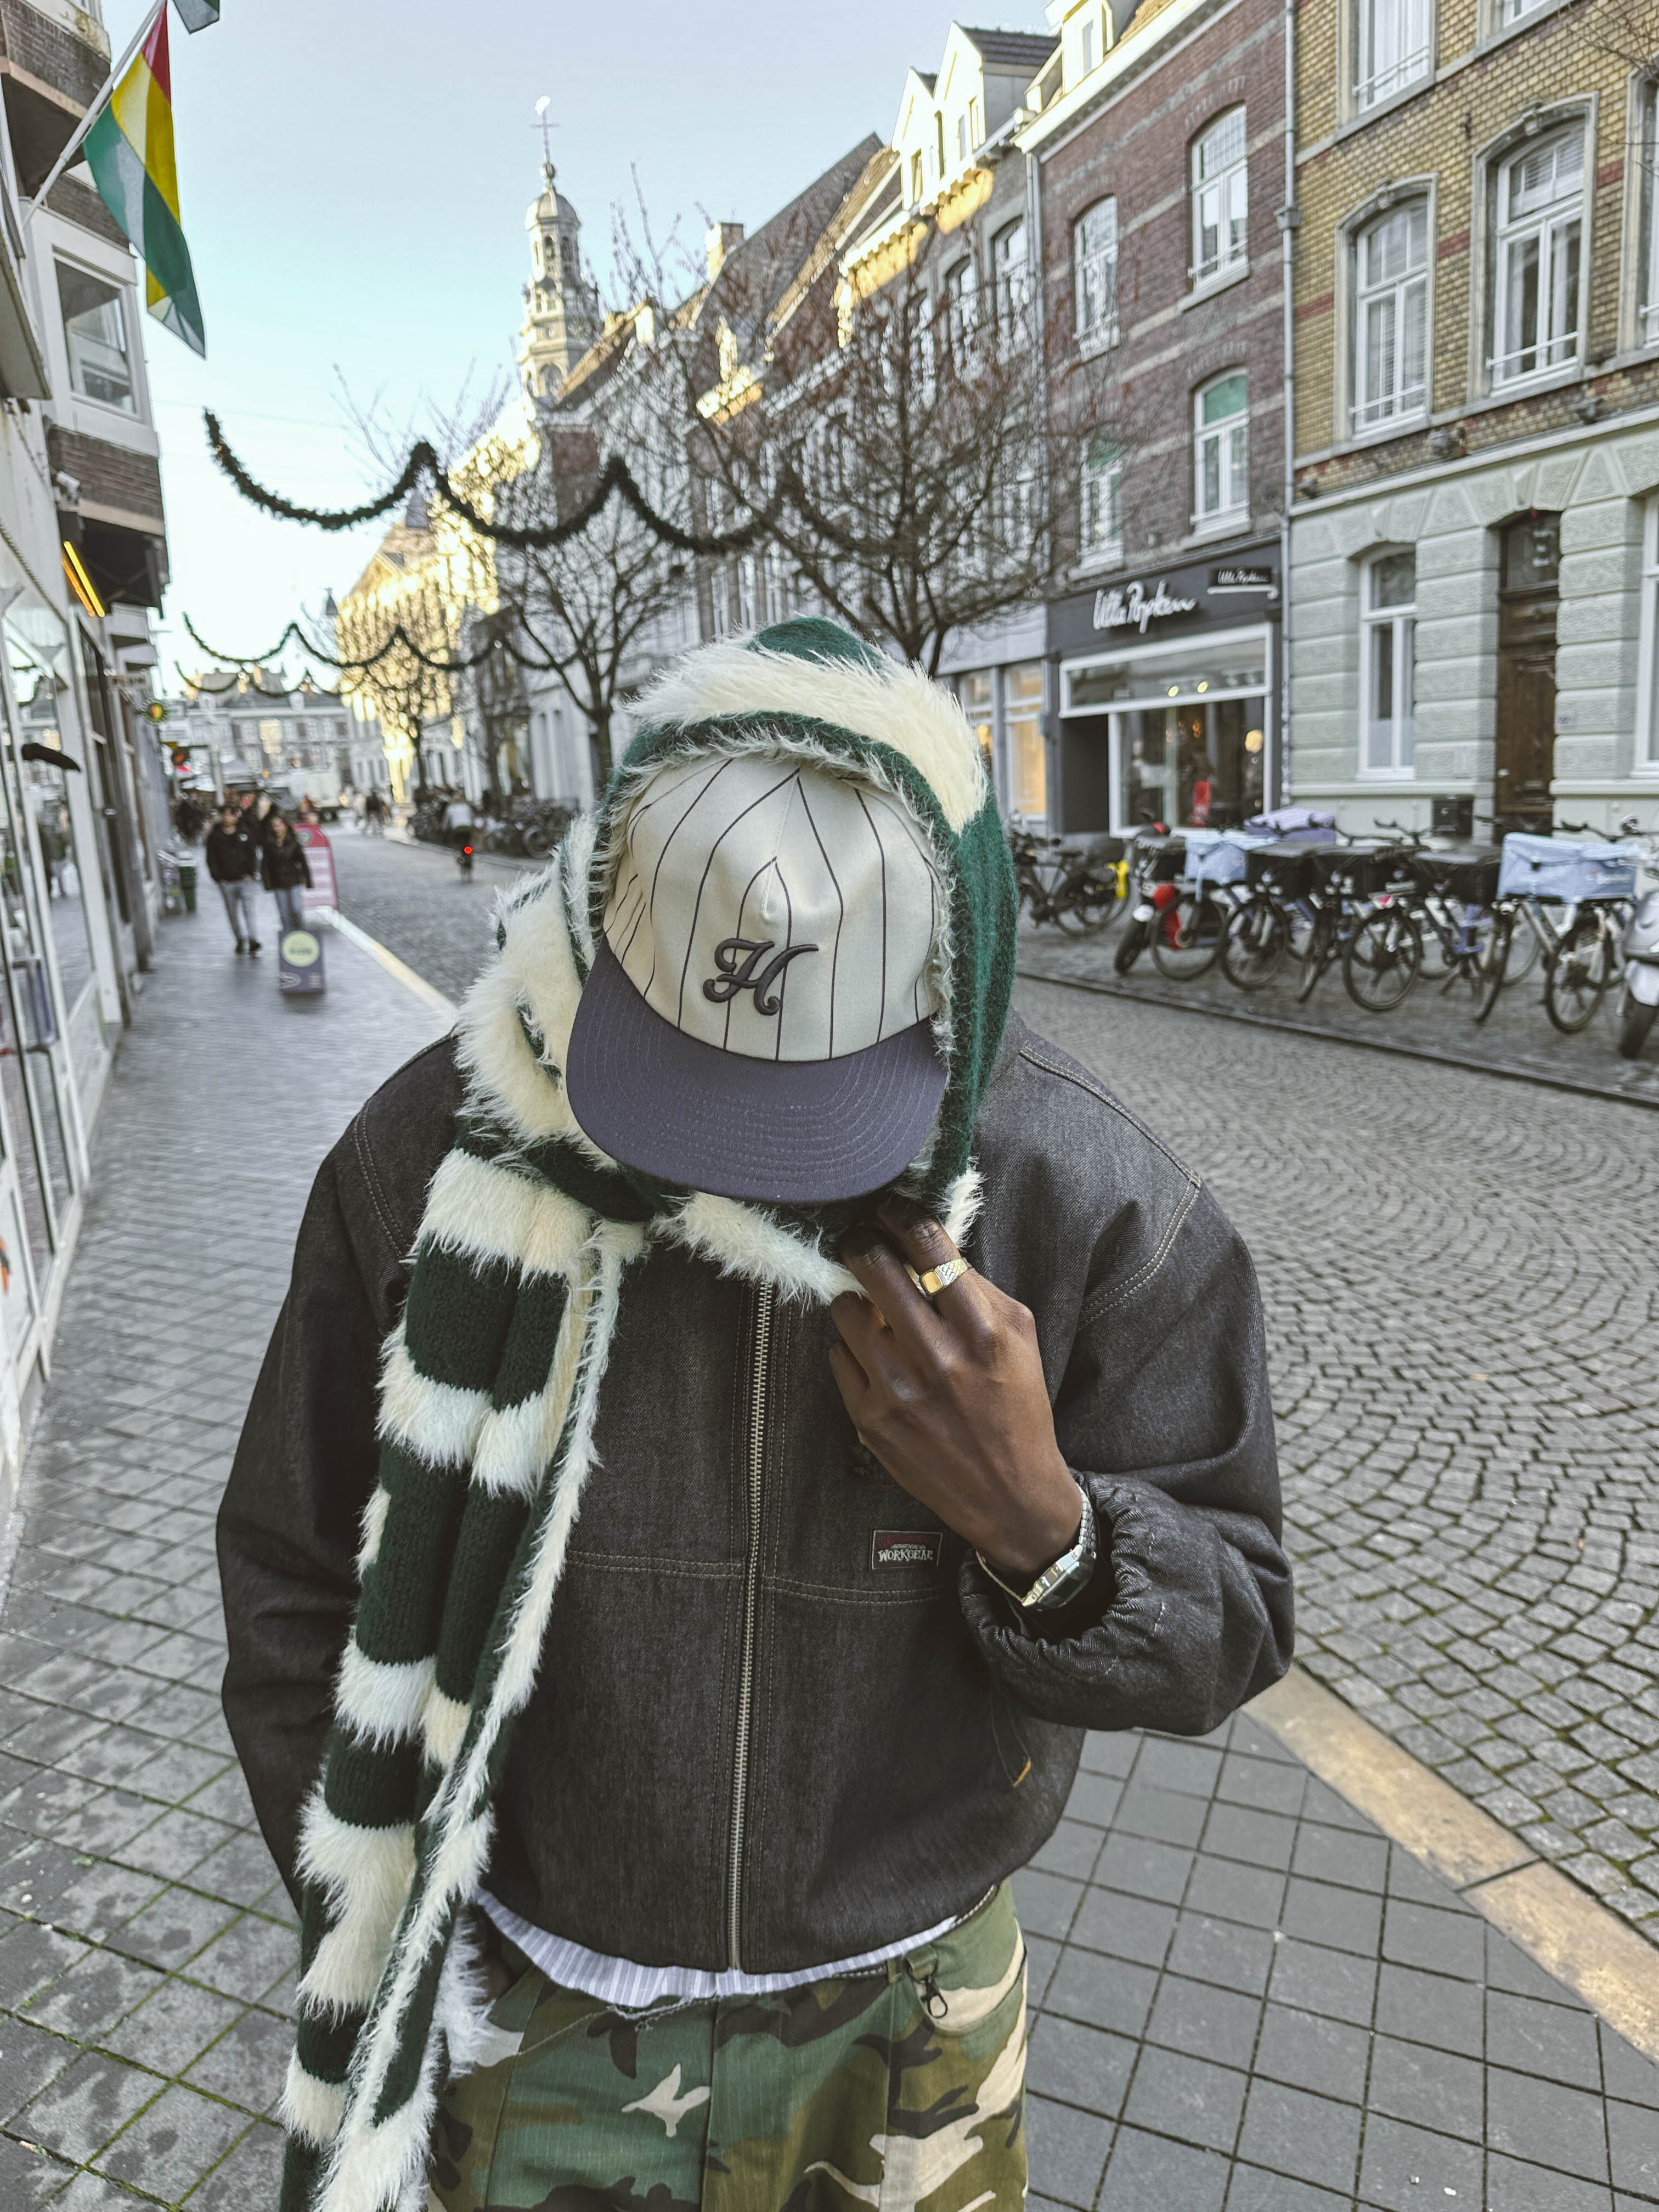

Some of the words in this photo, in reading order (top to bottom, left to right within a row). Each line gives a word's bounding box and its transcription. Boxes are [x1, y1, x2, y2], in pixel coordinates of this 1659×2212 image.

[1093, 588, 1127, 630] Ulla
[703, 938, 819, 1016] H
[878, 1549, 934, 1562] WORKGEAR
